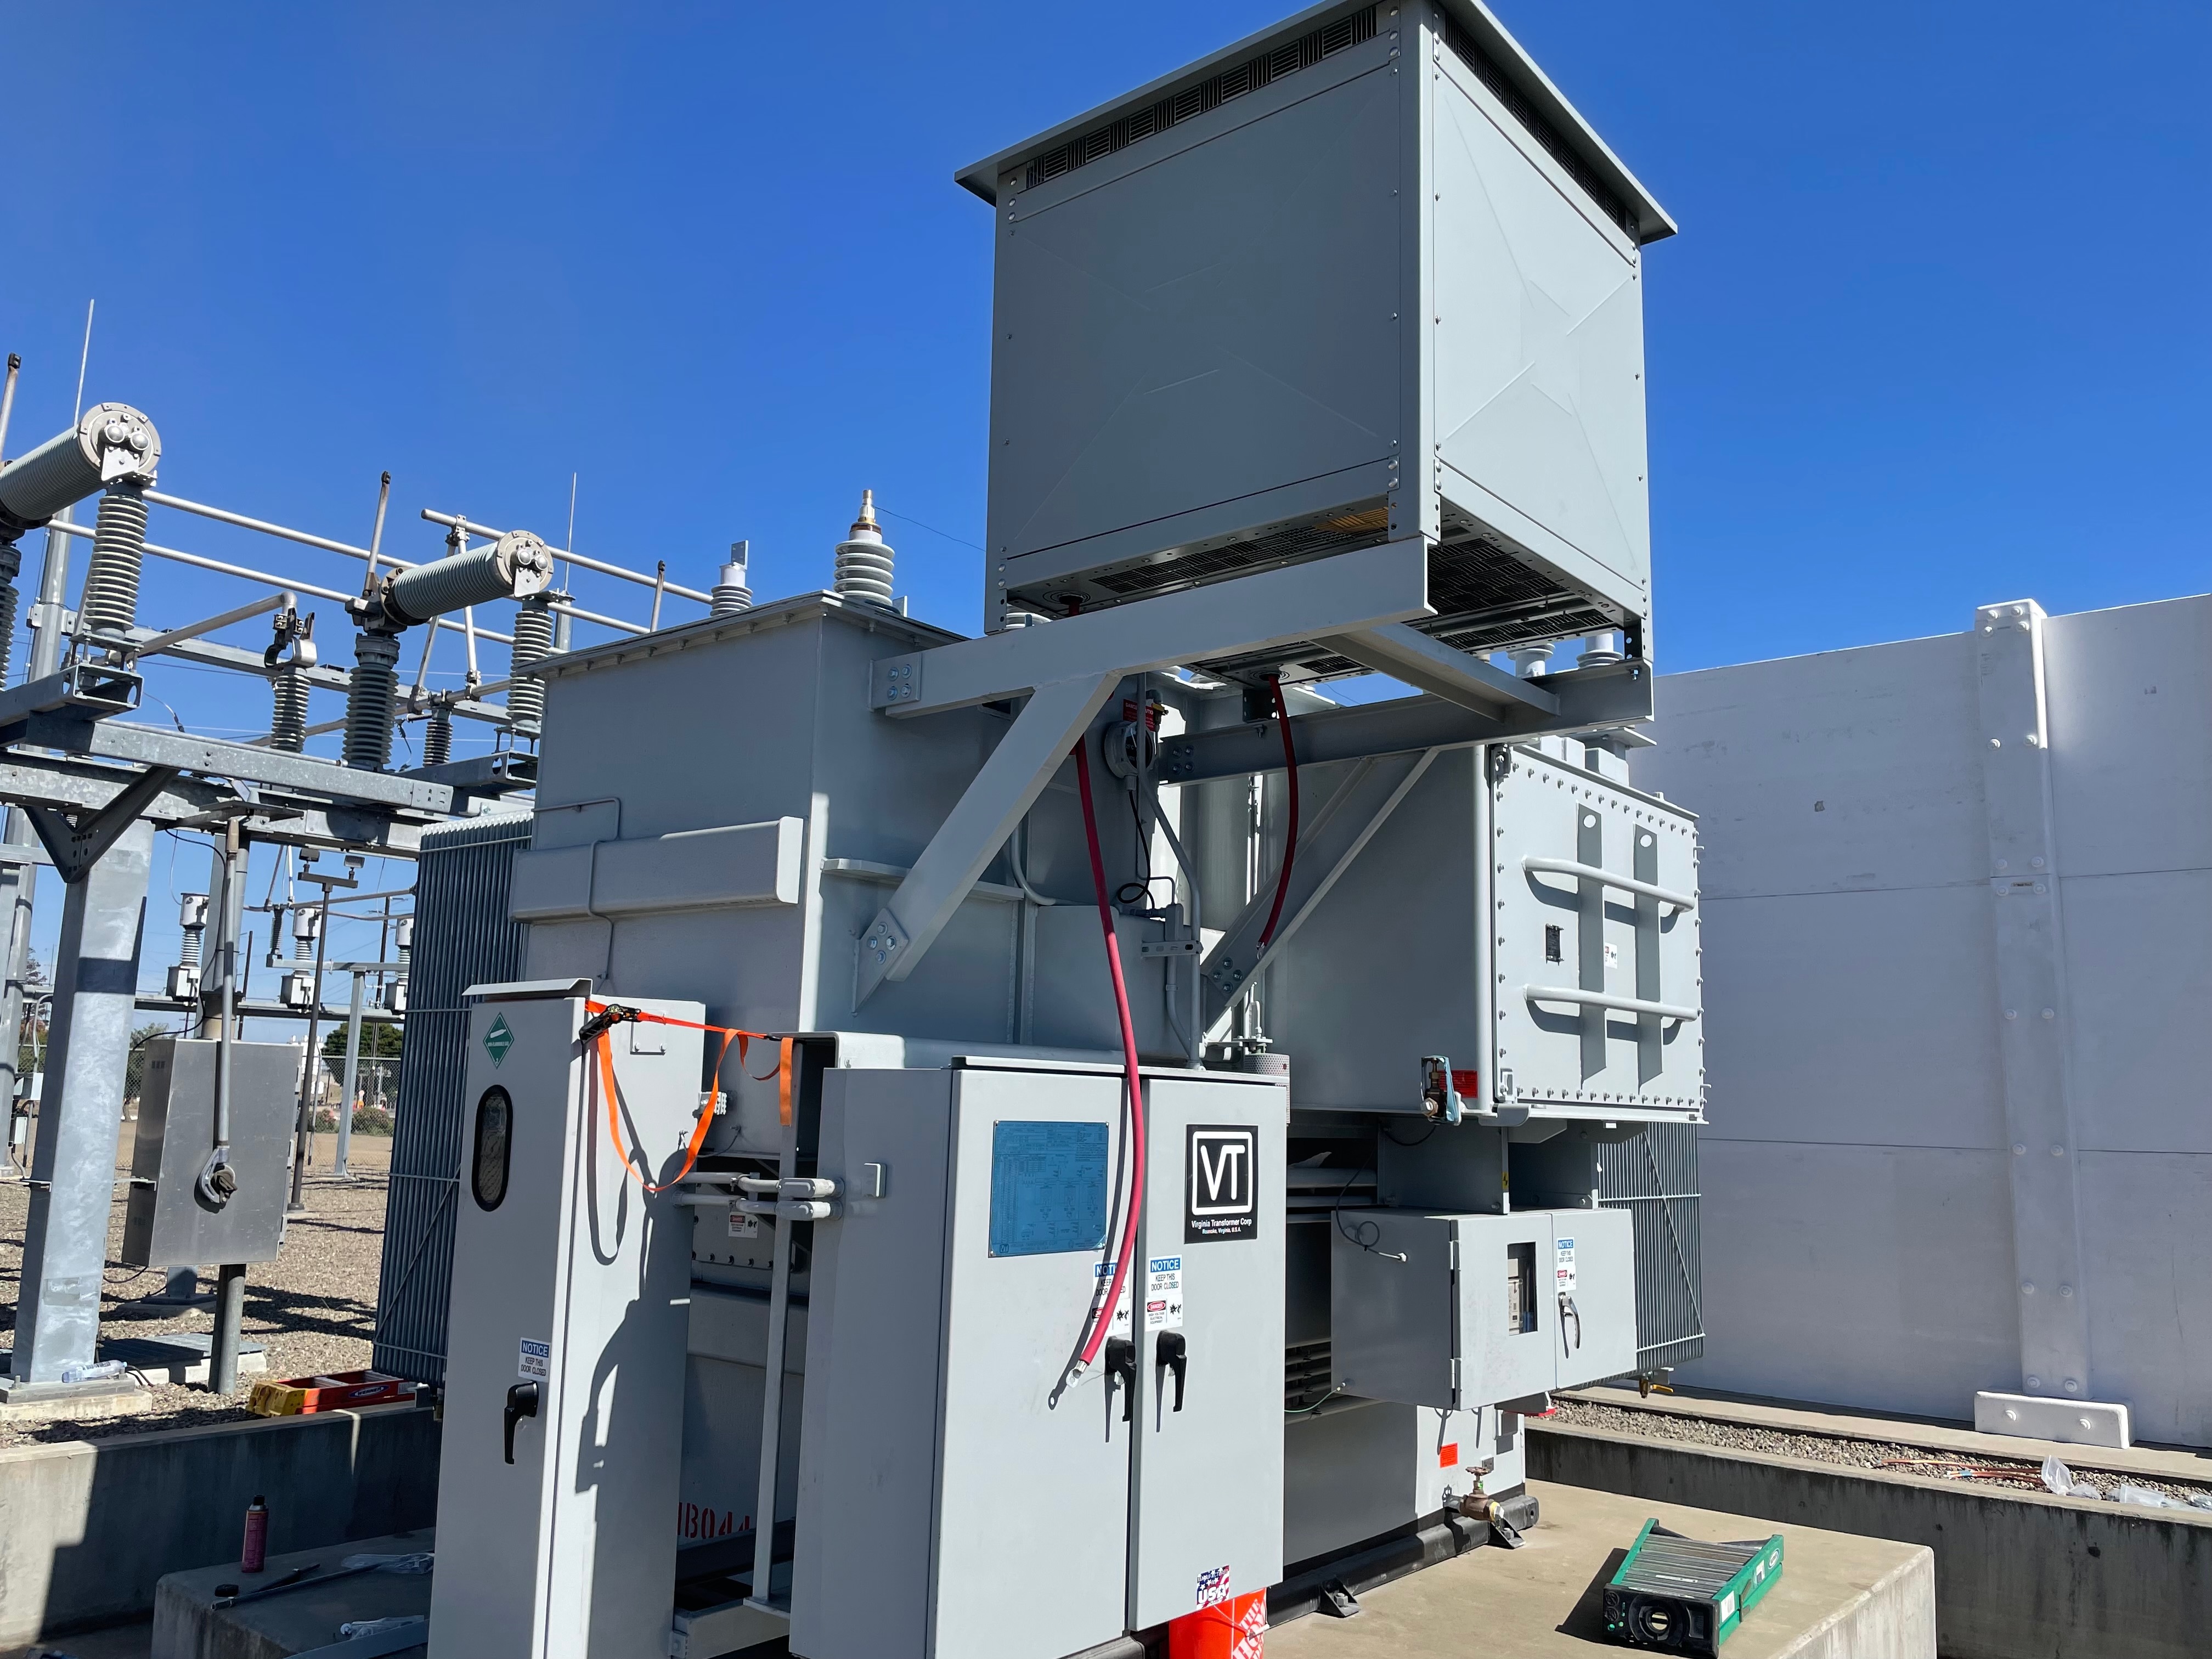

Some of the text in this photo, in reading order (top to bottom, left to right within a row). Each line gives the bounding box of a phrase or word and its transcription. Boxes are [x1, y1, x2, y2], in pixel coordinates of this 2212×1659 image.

[1200, 1144, 1245, 1201] VT
[1192, 1217, 1252, 1229] Virginia Transformer Corp
[1096, 1265, 1115, 1277] NOTI
[1152, 1259, 1179, 1272] NOTICE
[1101, 1279, 1112, 1287] KEEP
[1151, 1281, 1179, 1291] DOOR CLOSED
[1096, 1288, 1108, 1296] DOOR
[522, 1342, 548, 1356] NOTICE
[525, 1356, 535, 1364] KEEP
[521, 1364, 546, 1376] DOOR CLOSED
[358, 1387, 381, 1396] WERNER
[1198, 1584, 1226, 1604] USA
